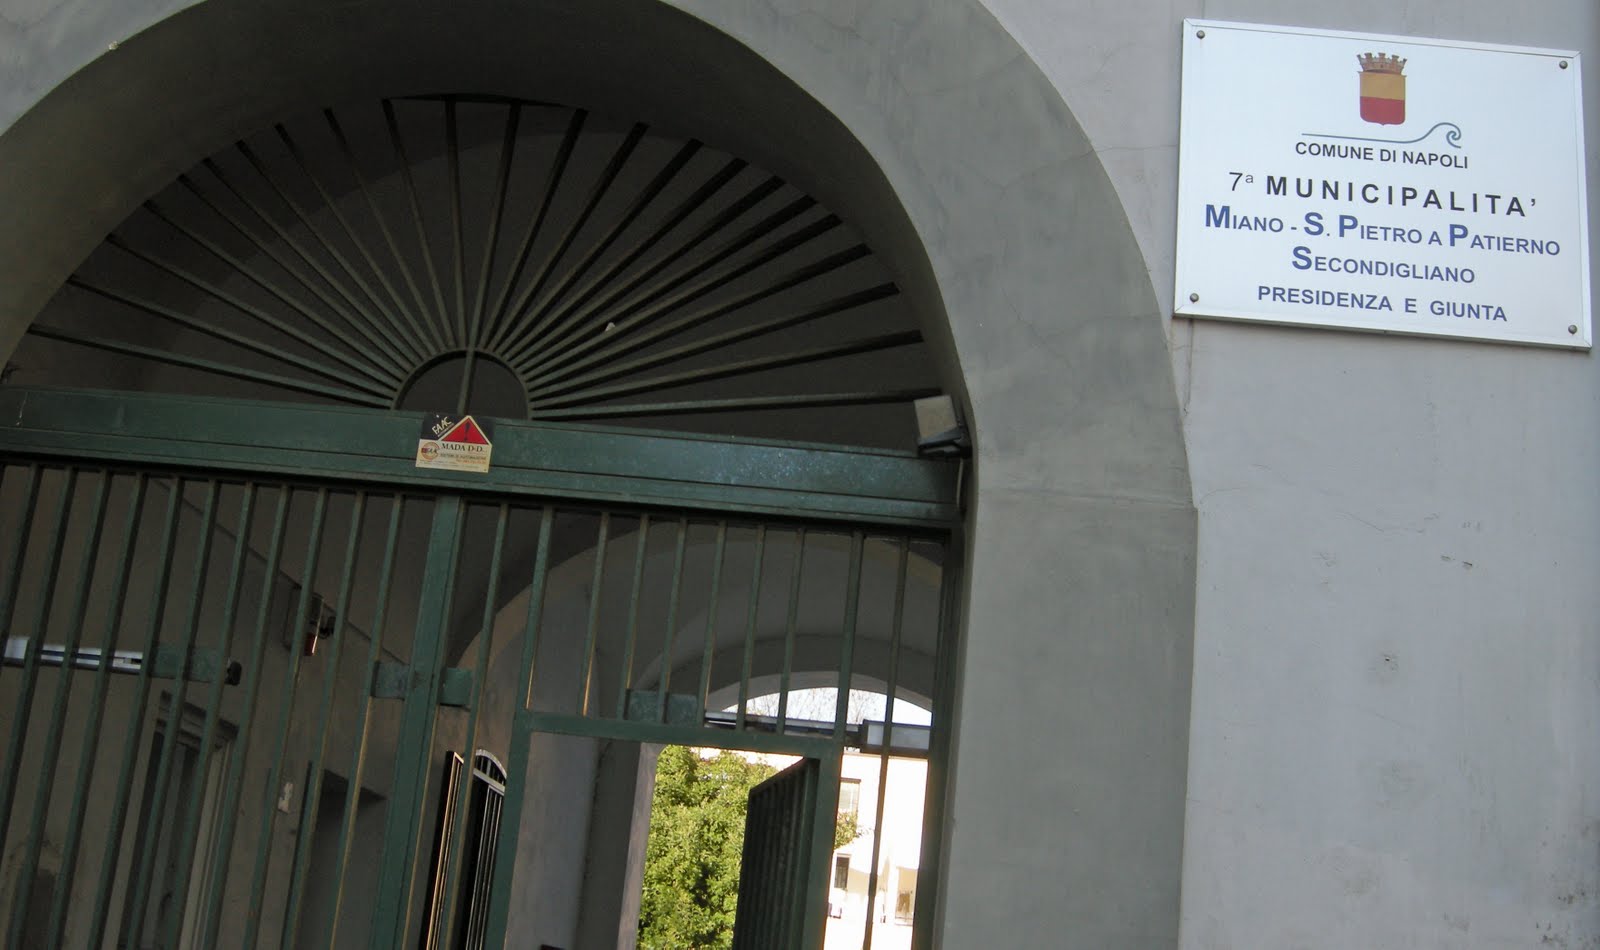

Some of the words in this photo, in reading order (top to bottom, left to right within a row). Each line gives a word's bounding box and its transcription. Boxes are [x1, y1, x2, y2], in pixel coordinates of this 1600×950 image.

[1295, 141, 1374, 161] COMUNE
[1379, 148, 1397, 163] DI
[1402, 150, 1468, 169] NAPOLI
[1303, 211, 1331, 236] S.
[1427, 230, 1443, 246] A
[1258, 285, 1393, 312] PRESIDENZA
[1404, 297, 1418, 314] E
[1429, 300, 1508, 322] GIUNTA
